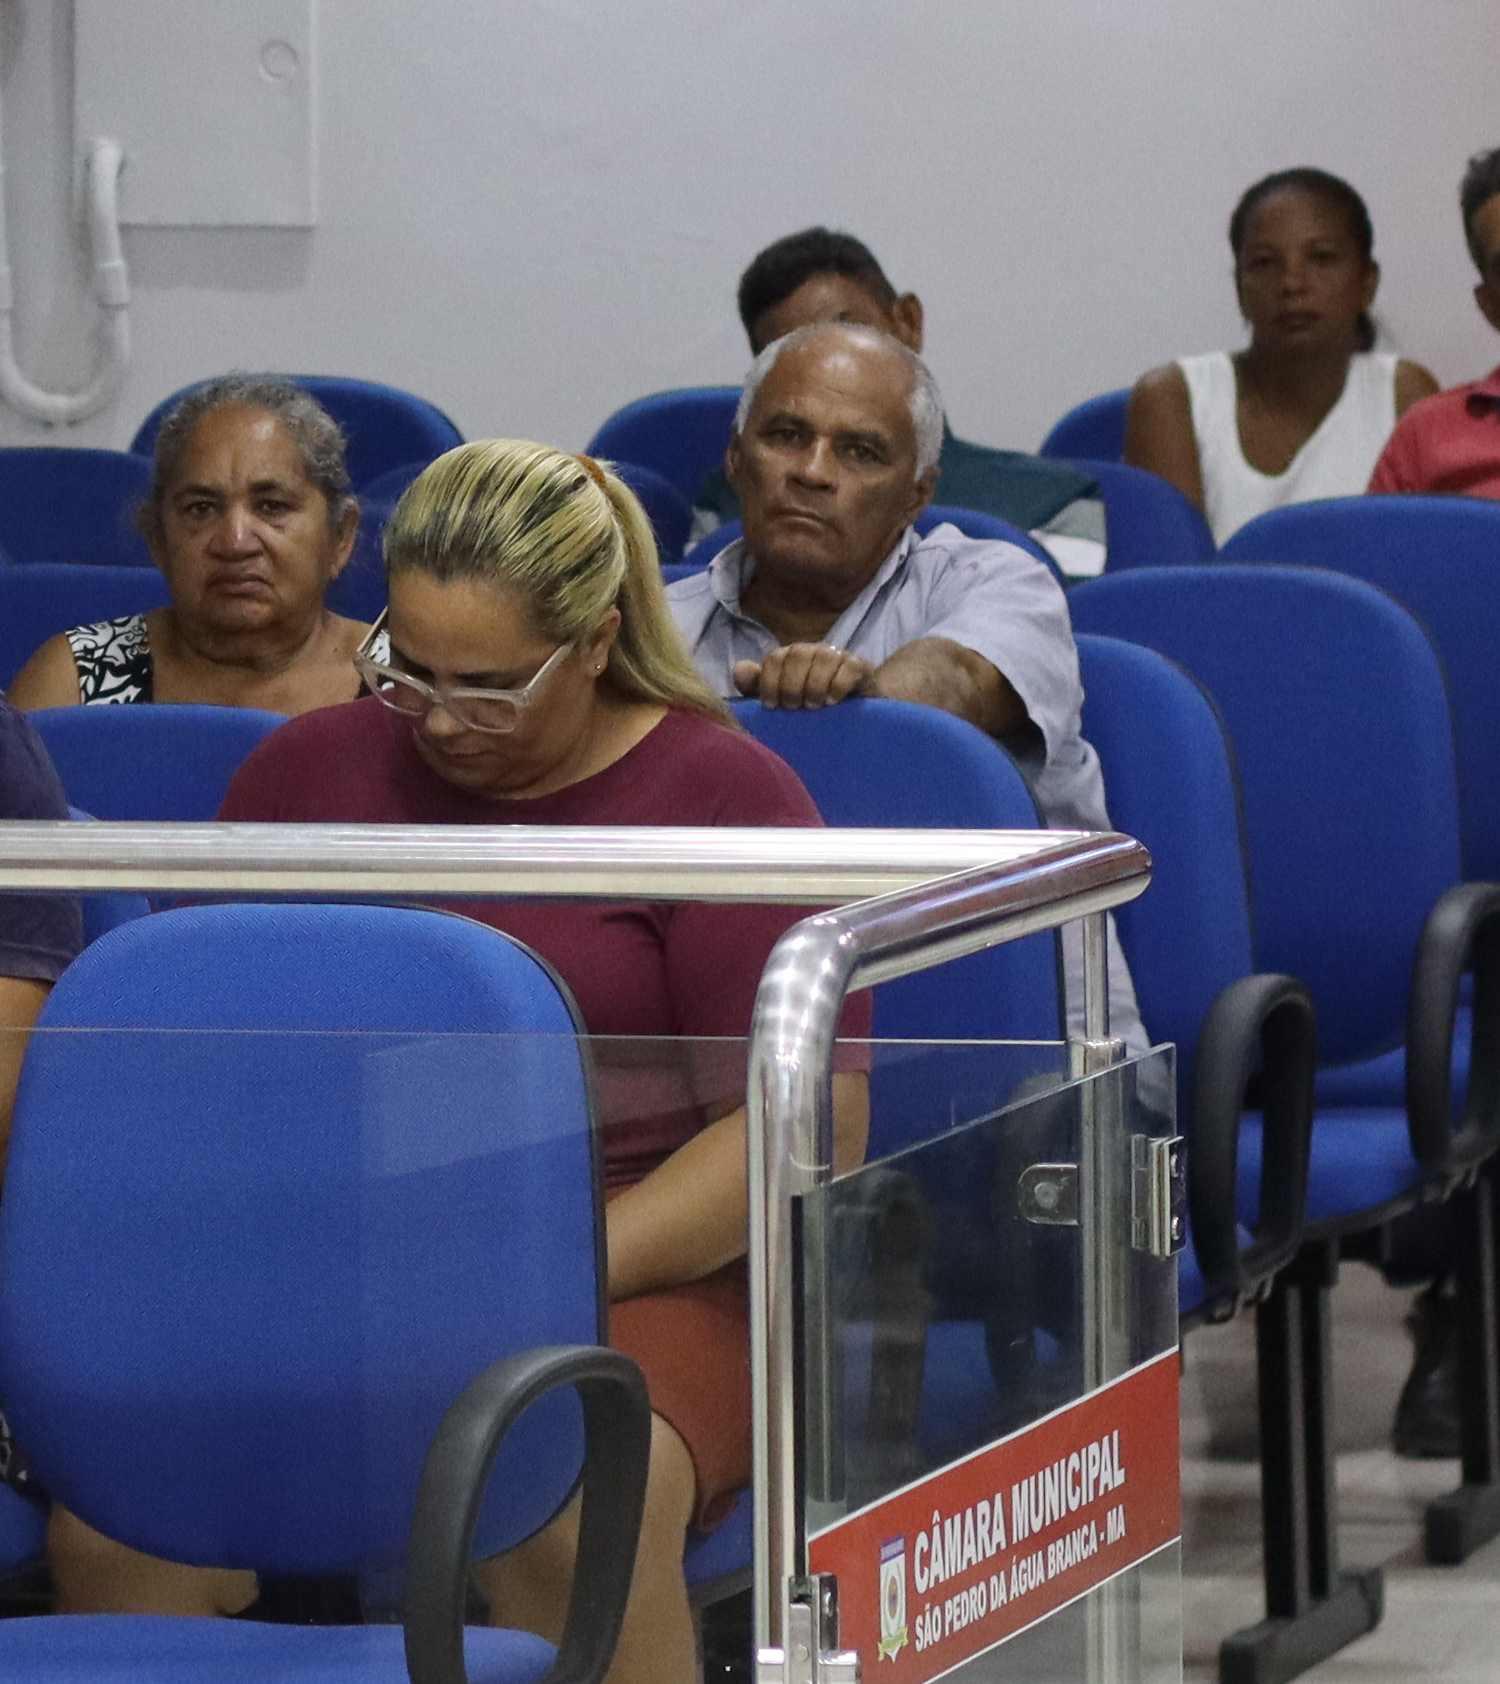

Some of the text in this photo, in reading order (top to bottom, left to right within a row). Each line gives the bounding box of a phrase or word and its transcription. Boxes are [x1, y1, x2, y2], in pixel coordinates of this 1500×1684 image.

[914, 1429, 1125, 1594] CÂMARA MUNICIPAL
[915, 1602, 942, 1652] SÃO
[945, 1580, 988, 1637] PEDRO
[990, 1570, 1007, 1612] DA
[1009, 1550, 1045, 1602] ÁGUA
[1048, 1520, 1098, 1580] BRANCA
[1107, 1504, 1126, 1545] MA
